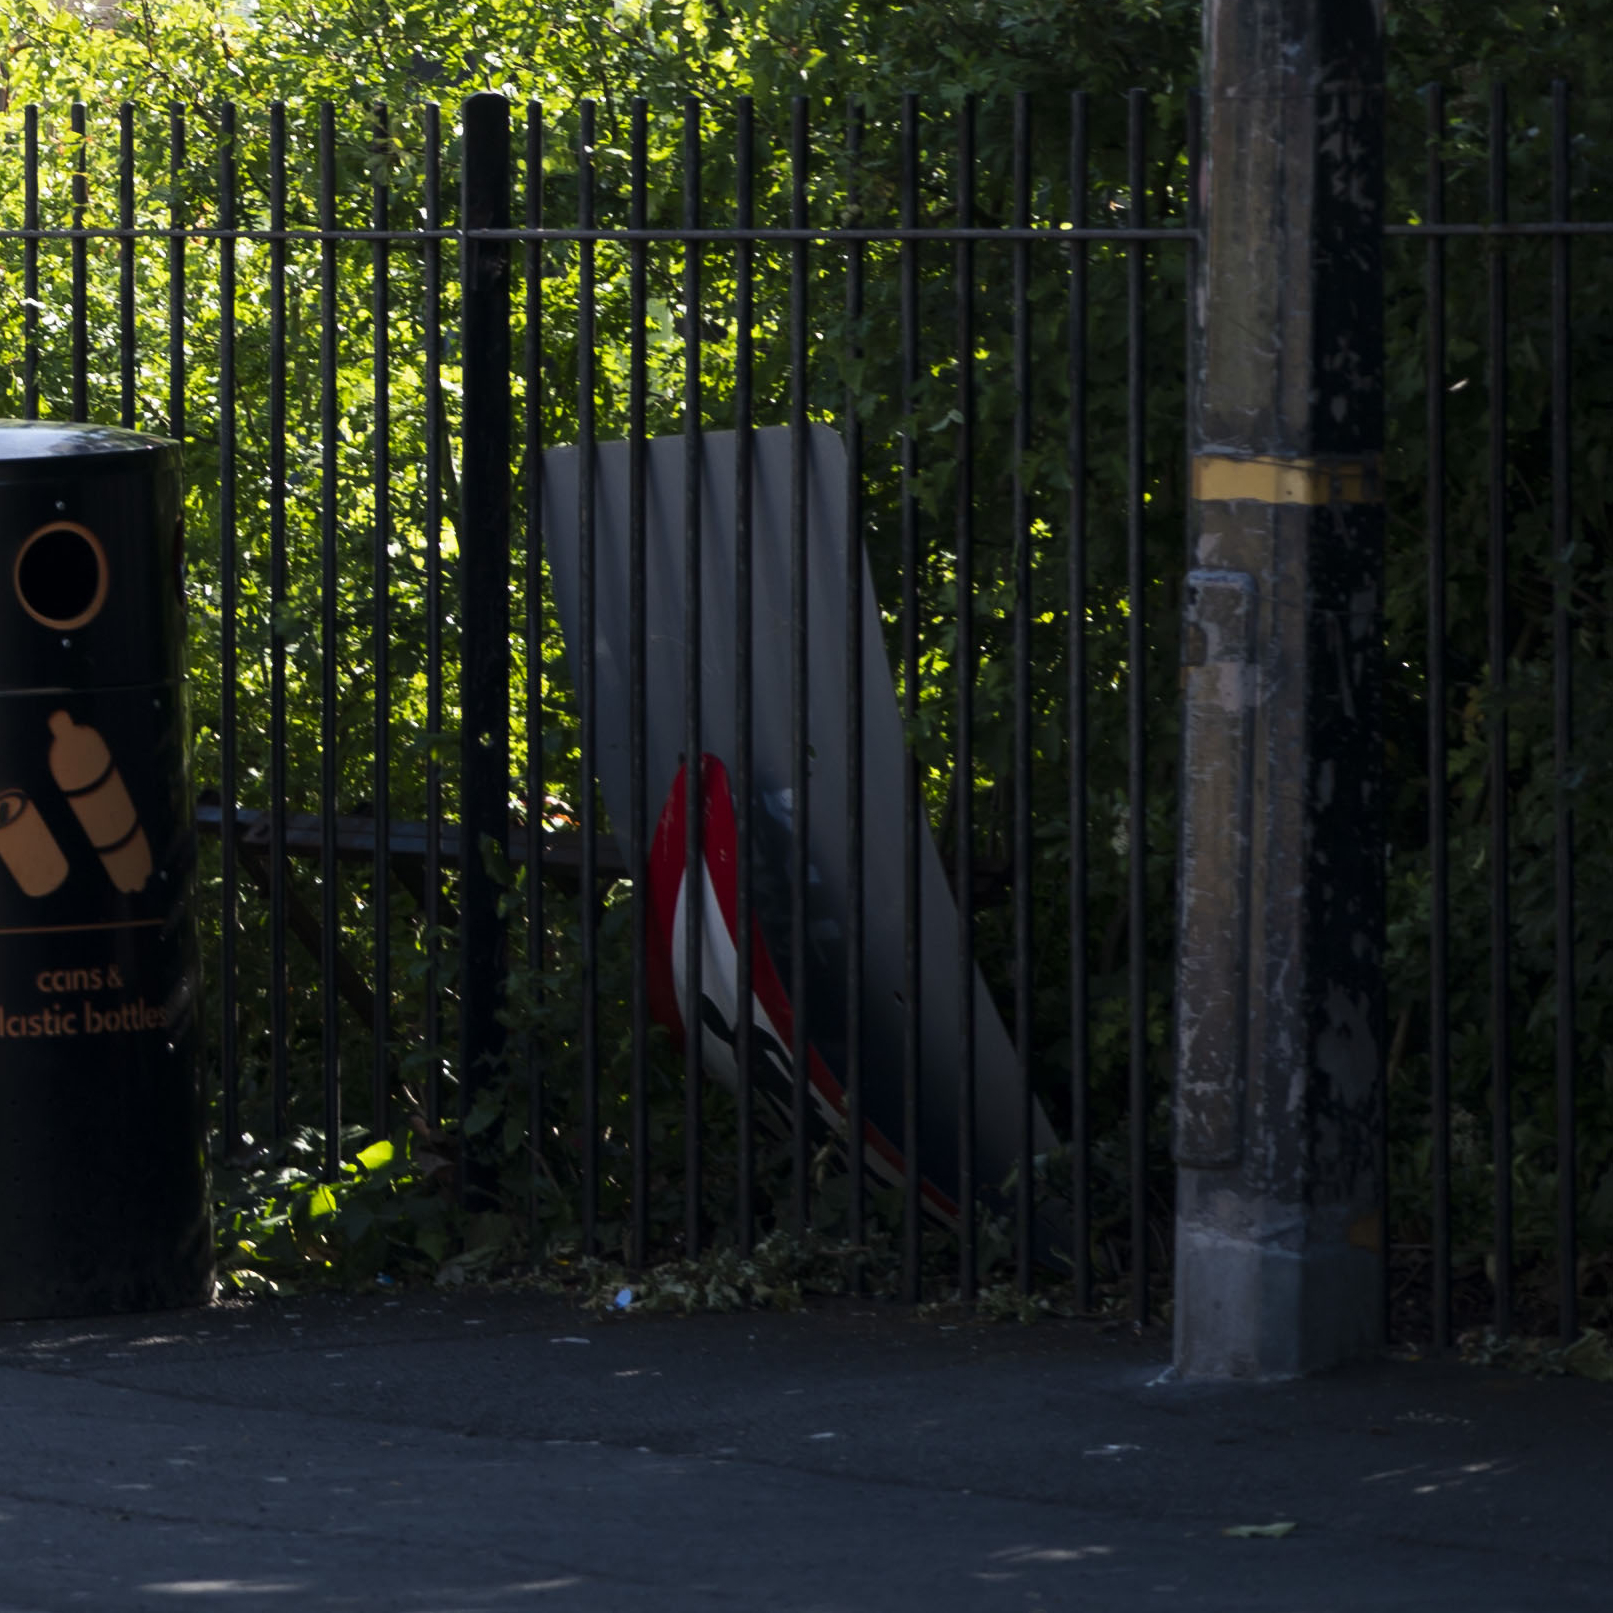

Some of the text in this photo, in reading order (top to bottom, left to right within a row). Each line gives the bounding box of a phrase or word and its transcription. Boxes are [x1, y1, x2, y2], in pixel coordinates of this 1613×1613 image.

[37, 964, 124, 993] cans &
[84, 996, 169, 1034] bottles
